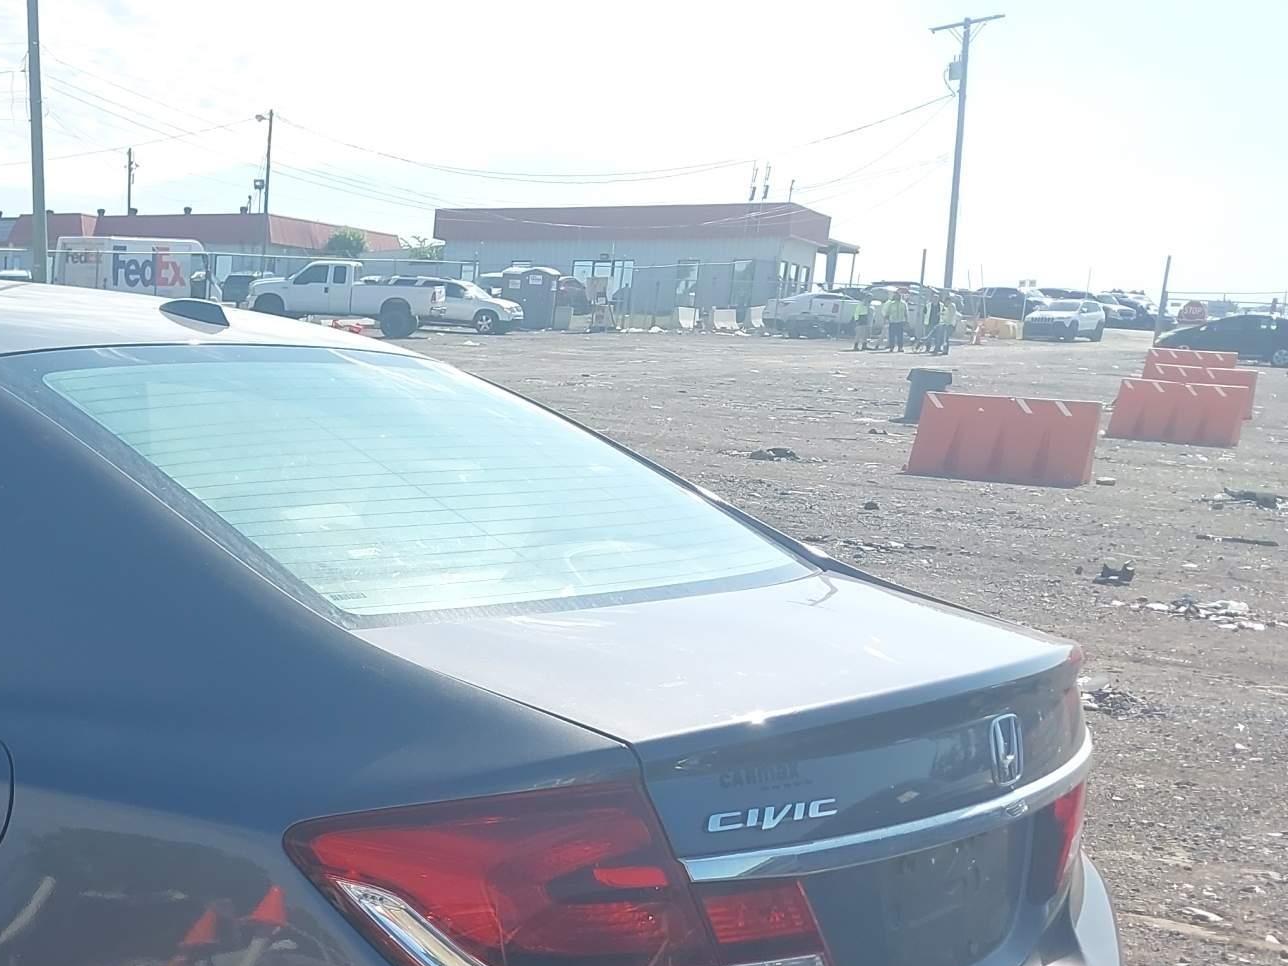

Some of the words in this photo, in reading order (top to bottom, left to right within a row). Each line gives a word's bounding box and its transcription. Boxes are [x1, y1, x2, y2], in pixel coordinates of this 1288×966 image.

[65, 248, 103, 264] FedEx
[112, 244, 187, 288] FedEx
[706, 797, 839, 834] CIVIC
